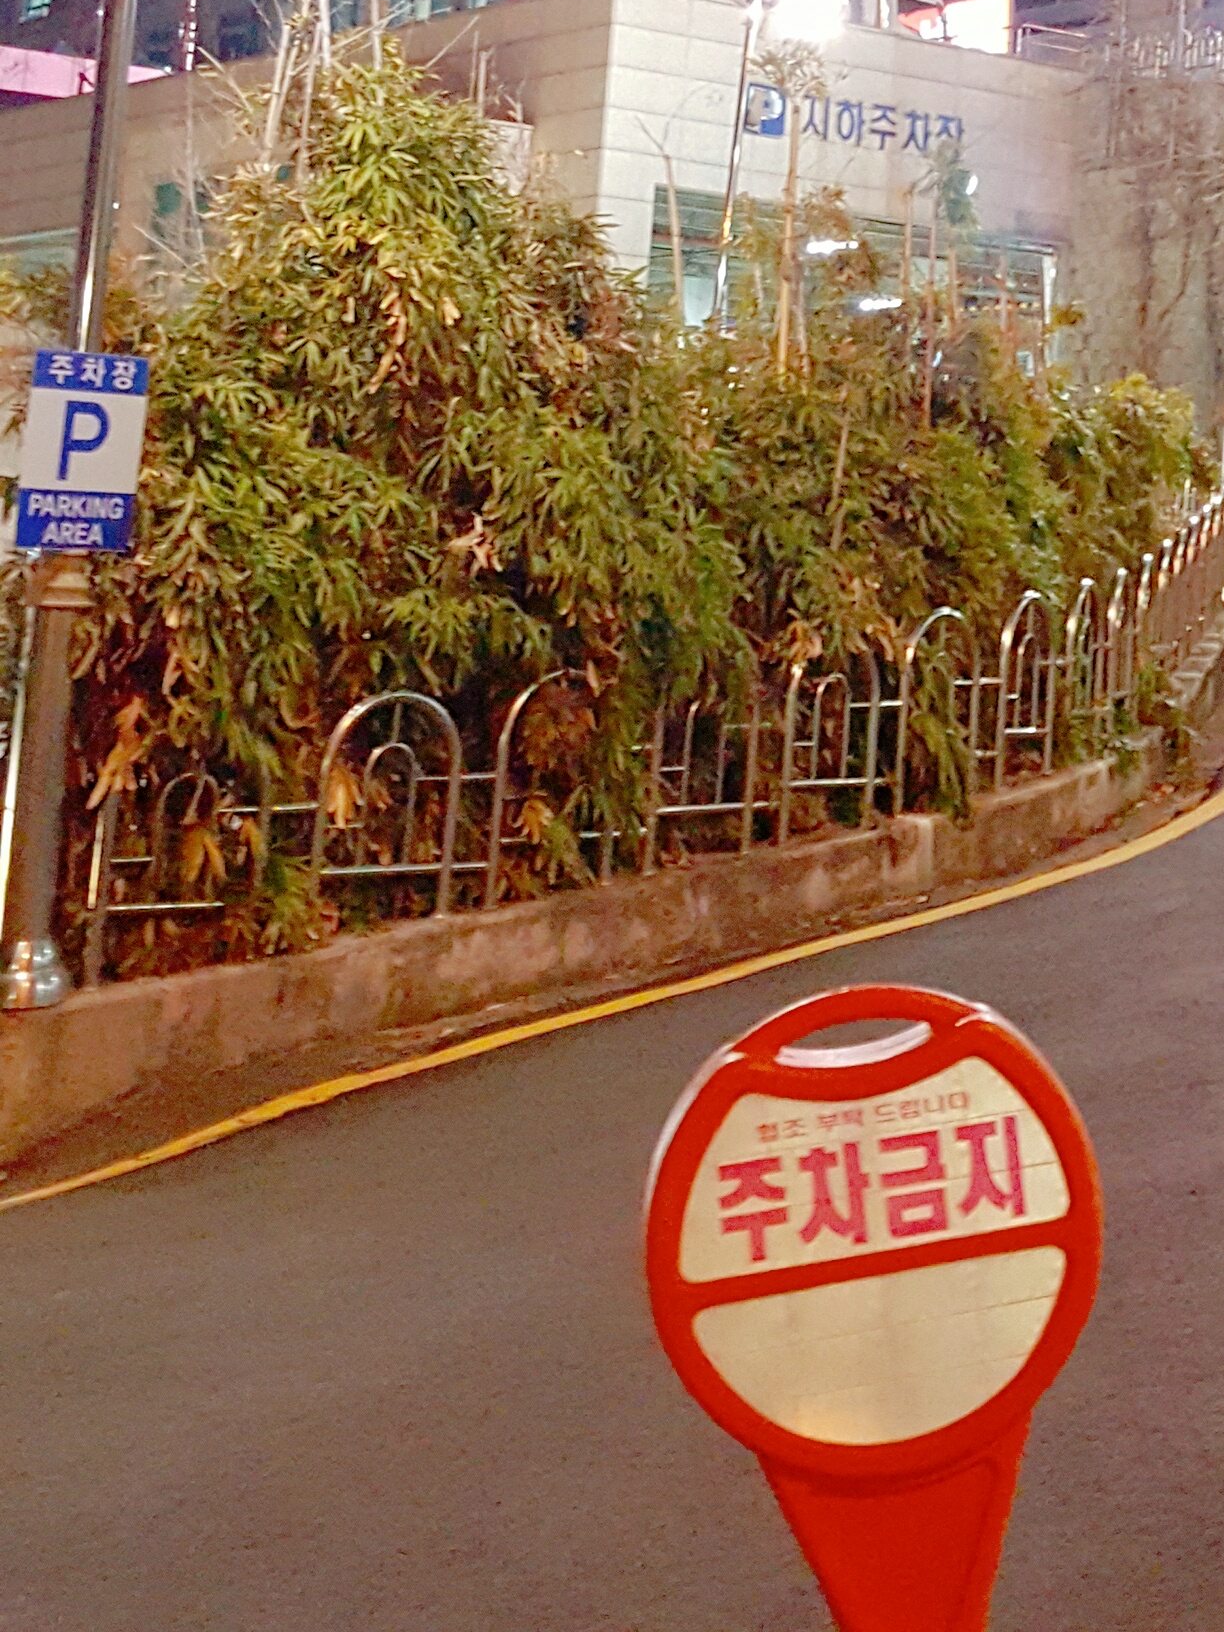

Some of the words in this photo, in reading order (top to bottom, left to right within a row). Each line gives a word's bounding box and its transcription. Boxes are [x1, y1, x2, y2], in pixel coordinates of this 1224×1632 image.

[49, 354, 138, 391] 주차장
[57, 400, 110, 481] P
[27, 493, 125, 520] PARKING
[41, 521, 104, 546] AREA
[757, 1119, 806, 1145] 협조
[817, 1108, 865, 1133] 부탁
[873, 1090, 971, 1124] 드립니다
[718, 1114, 1027, 1261] 주차금지
